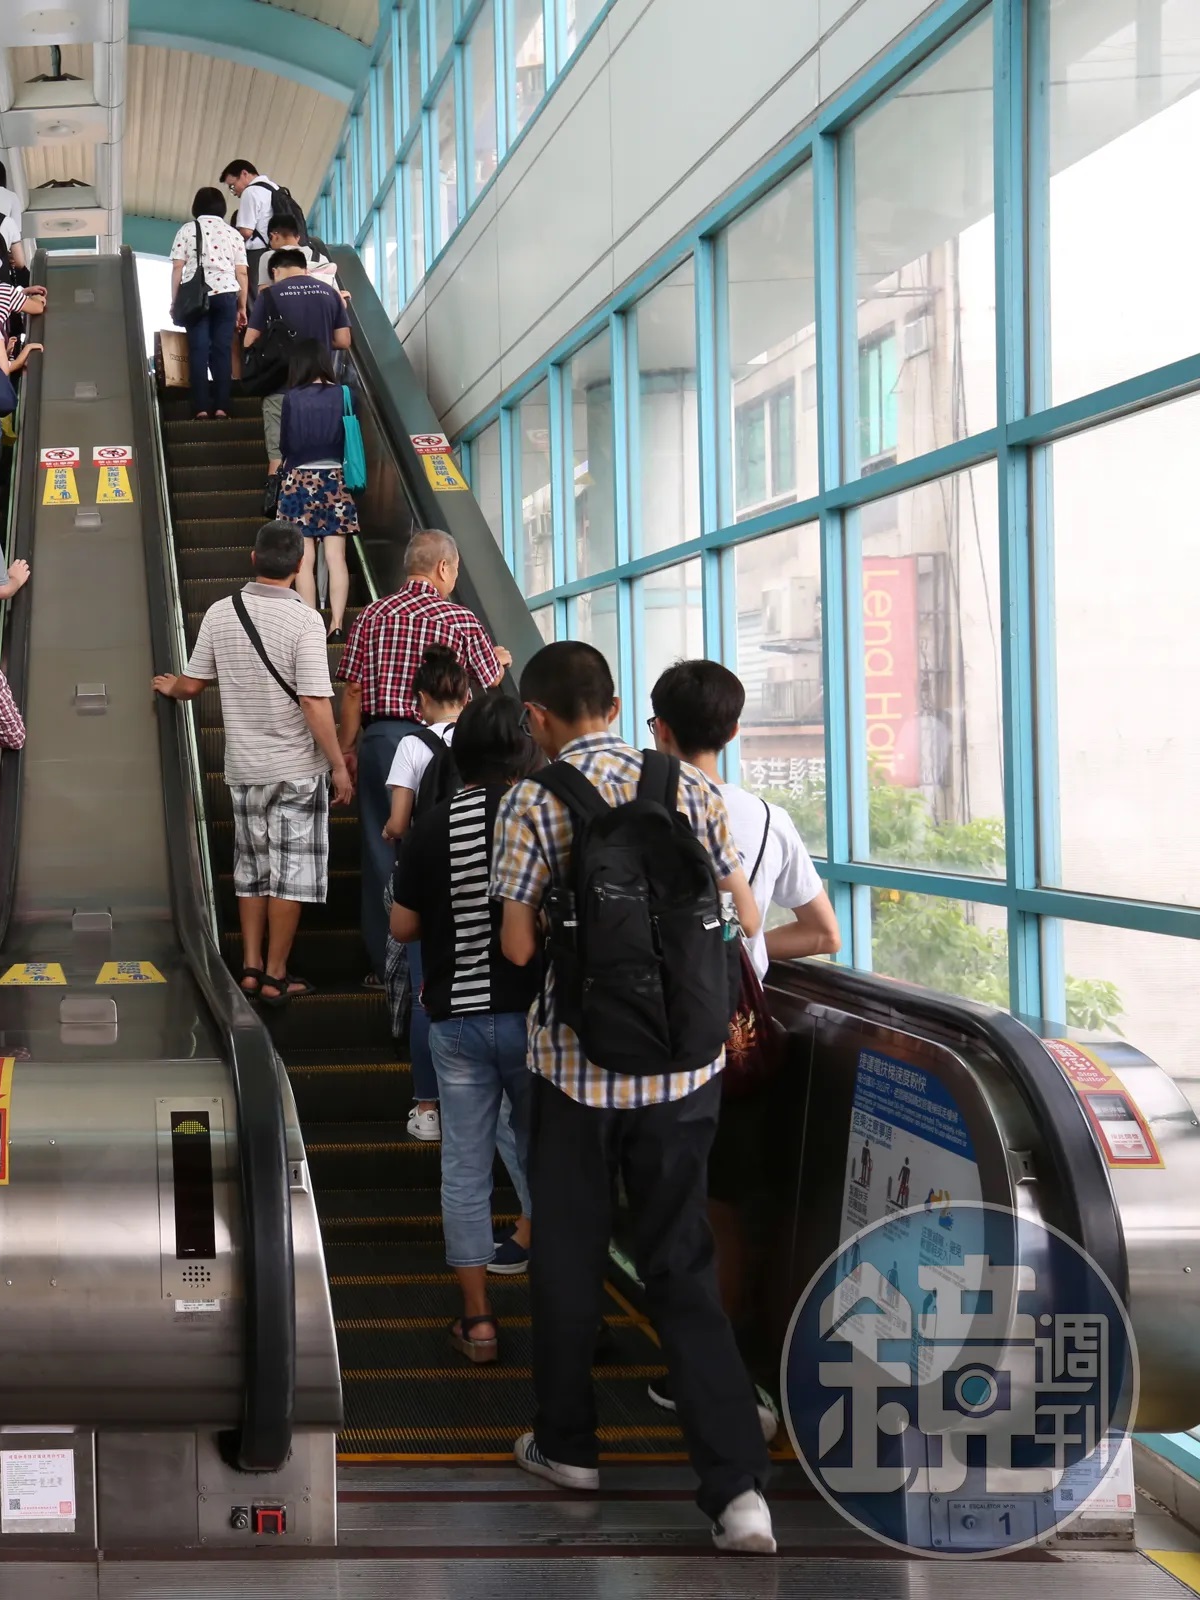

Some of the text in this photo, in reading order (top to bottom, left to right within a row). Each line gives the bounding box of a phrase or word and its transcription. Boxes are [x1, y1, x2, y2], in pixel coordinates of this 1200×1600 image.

[863, 569, 902, 778] Lena Hair
[998, 1512, 1011, 1536] 1
